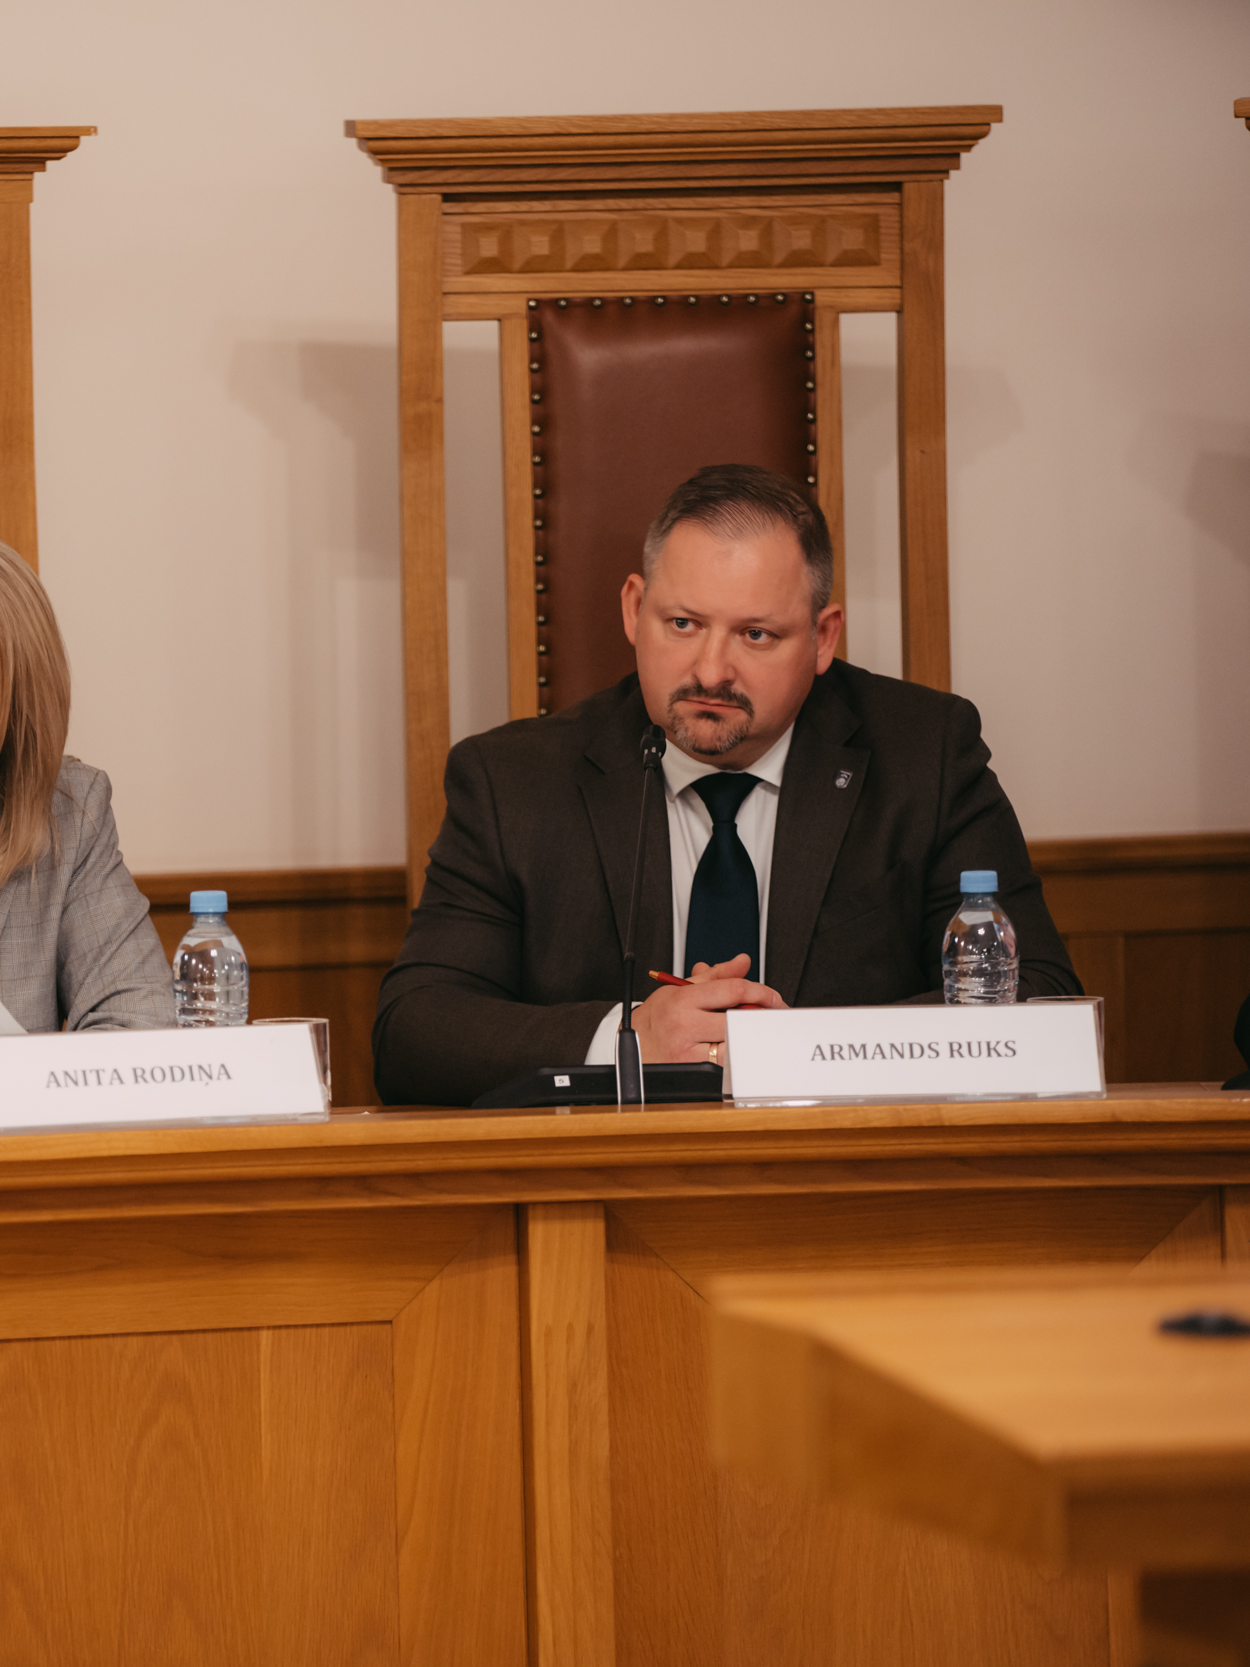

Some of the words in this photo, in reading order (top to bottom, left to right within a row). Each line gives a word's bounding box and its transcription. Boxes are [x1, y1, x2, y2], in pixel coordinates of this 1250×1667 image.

[810, 1041, 940, 1061] ARMANDS
[948, 1040, 1017, 1059] RUKS
[45, 1068, 125, 1089] ANITA
[131, 1063, 233, 1086] RODIŅA
